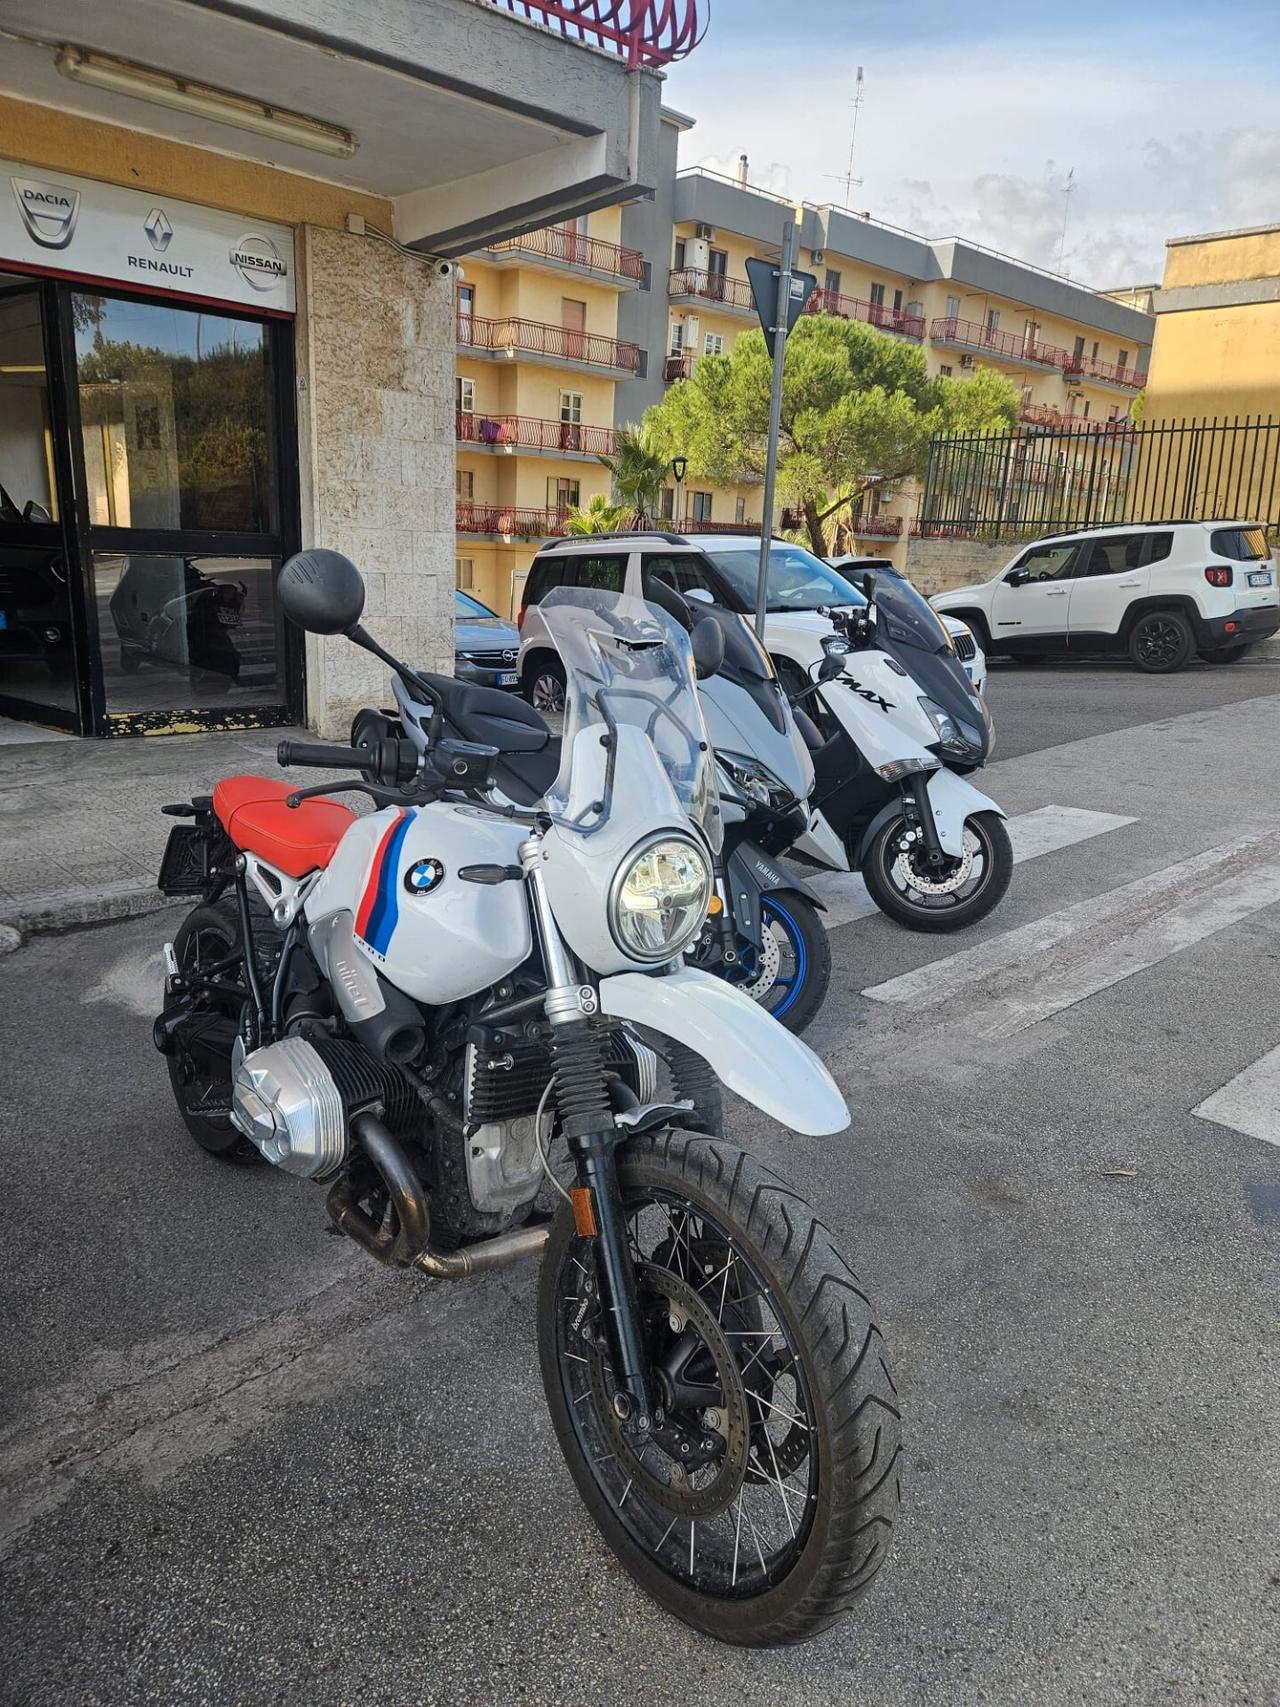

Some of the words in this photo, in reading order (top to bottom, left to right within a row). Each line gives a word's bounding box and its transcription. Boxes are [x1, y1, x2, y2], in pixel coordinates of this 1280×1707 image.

[23, 189, 70, 208] DACIA
[127, 255, 194, 278] RENAULT
[234, 252, 282, 271] NISSAN
[755, 861, 780, 885] YAMAHA
[571, 1298, 589, 1331] brembo
